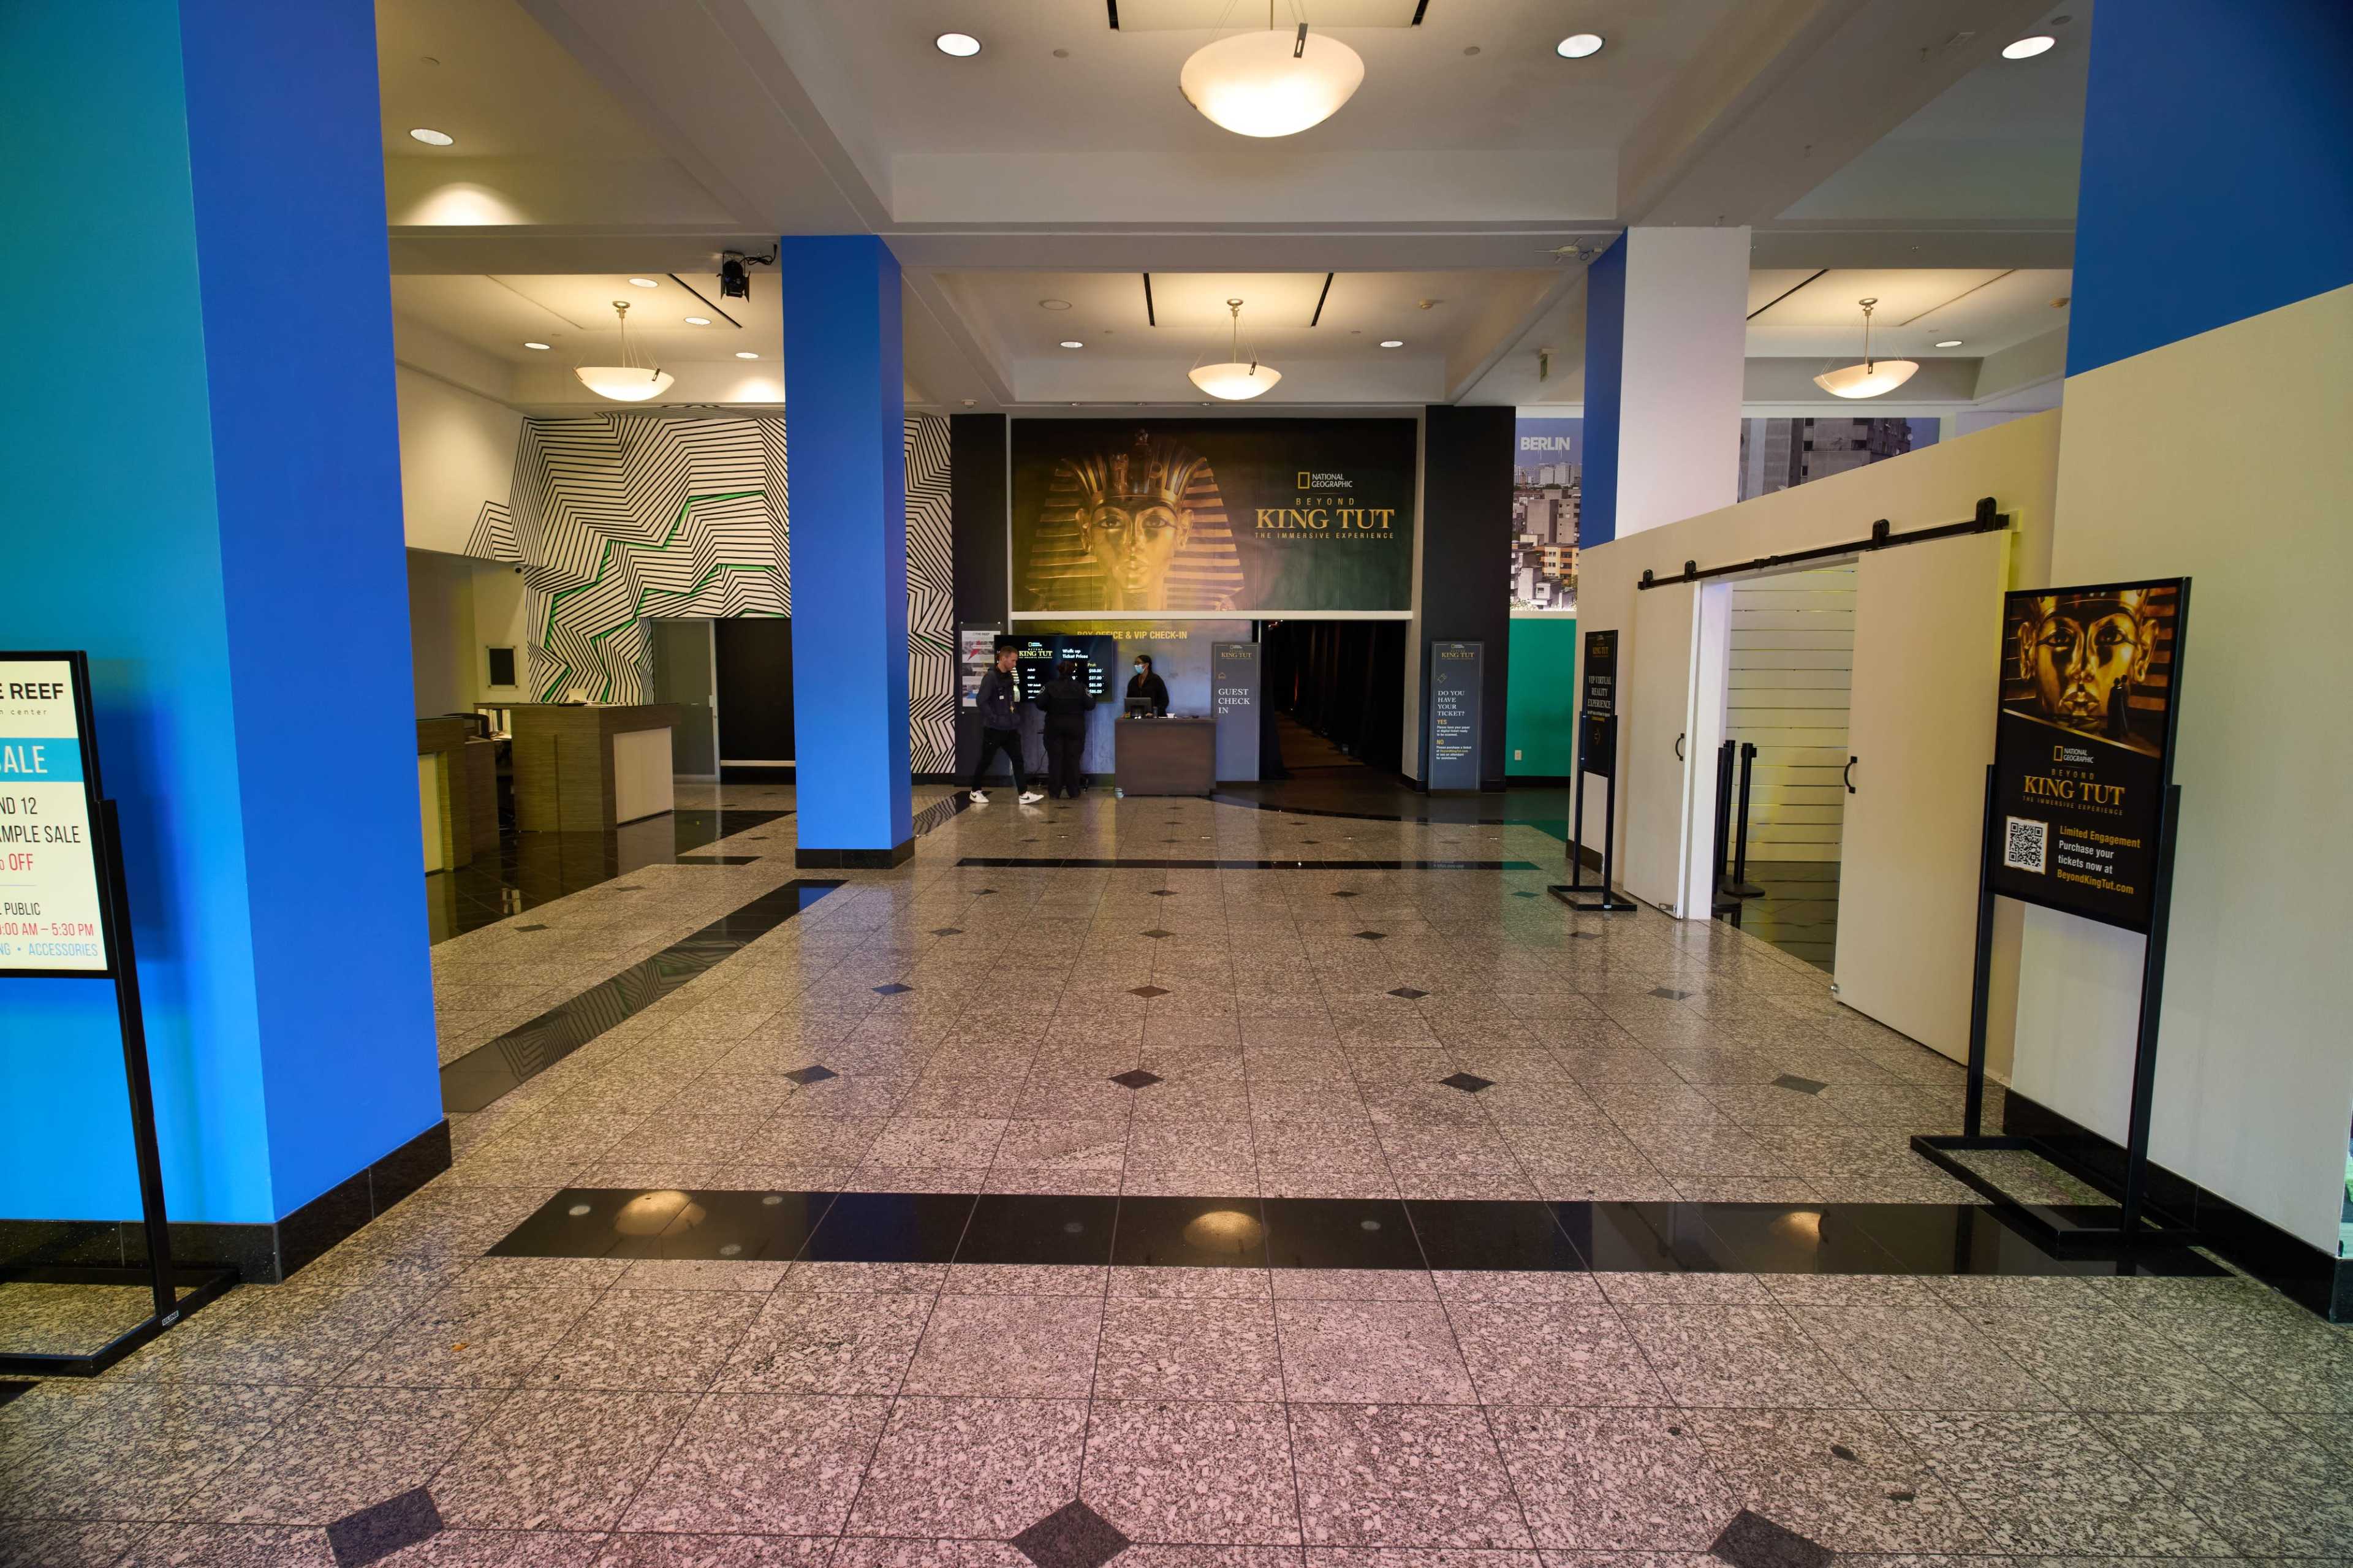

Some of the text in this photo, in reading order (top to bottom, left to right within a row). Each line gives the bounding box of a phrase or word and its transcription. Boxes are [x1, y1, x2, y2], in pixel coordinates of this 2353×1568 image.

[1520, 436, 1571, 451] BERLIN
[1254, 509, 1395, 529] KING TUT
[1125, 631, 1132, 639] &
[1134, 631, 1148, 639] VIP
[1150, 631, 1188, 639] CHECK-IN
[9, 683, 64, 700] REEF
[1591, 687, 1608, 697] REALITY
[1588, 699, 1611, 709] EXPERIENCE
[0, 744, 48, 774] ALE
[2063, 748, 2088, 756] NATIONAL
[2063, 754, 2094, 763] GEOGRAPHIC
[2051, 768, 2096, 780] BEYOND
[2023, 775, 2126, 806] KING TUT
[0, 797, 38, 815] ND 12
[2037, 797, 2074, 809] IMMERSIVE
[2078, 803, 2123, 816] EXPERIENCE
[0, 825, 81, 843] MPLE SALE
[2059, 825, 2142, 849] Limited Engagement
[2059, 839, 2115, 859] Purchase your
[8, 853, 34, 871] OFF
[2058, 854, 2113, 874] tickets now at
[2056, 869, 2135, 895] BeyondKingTut.com
[4, 902, 41, 916] PUBLIC
[0, 922, 18, 936] :00
[21, 922, 38, 936] AM
[51, 923, 75, 936] 5:30
[78, 923, 94, 936] PM
[29, 942, 99, 957] ACCESSORIES
